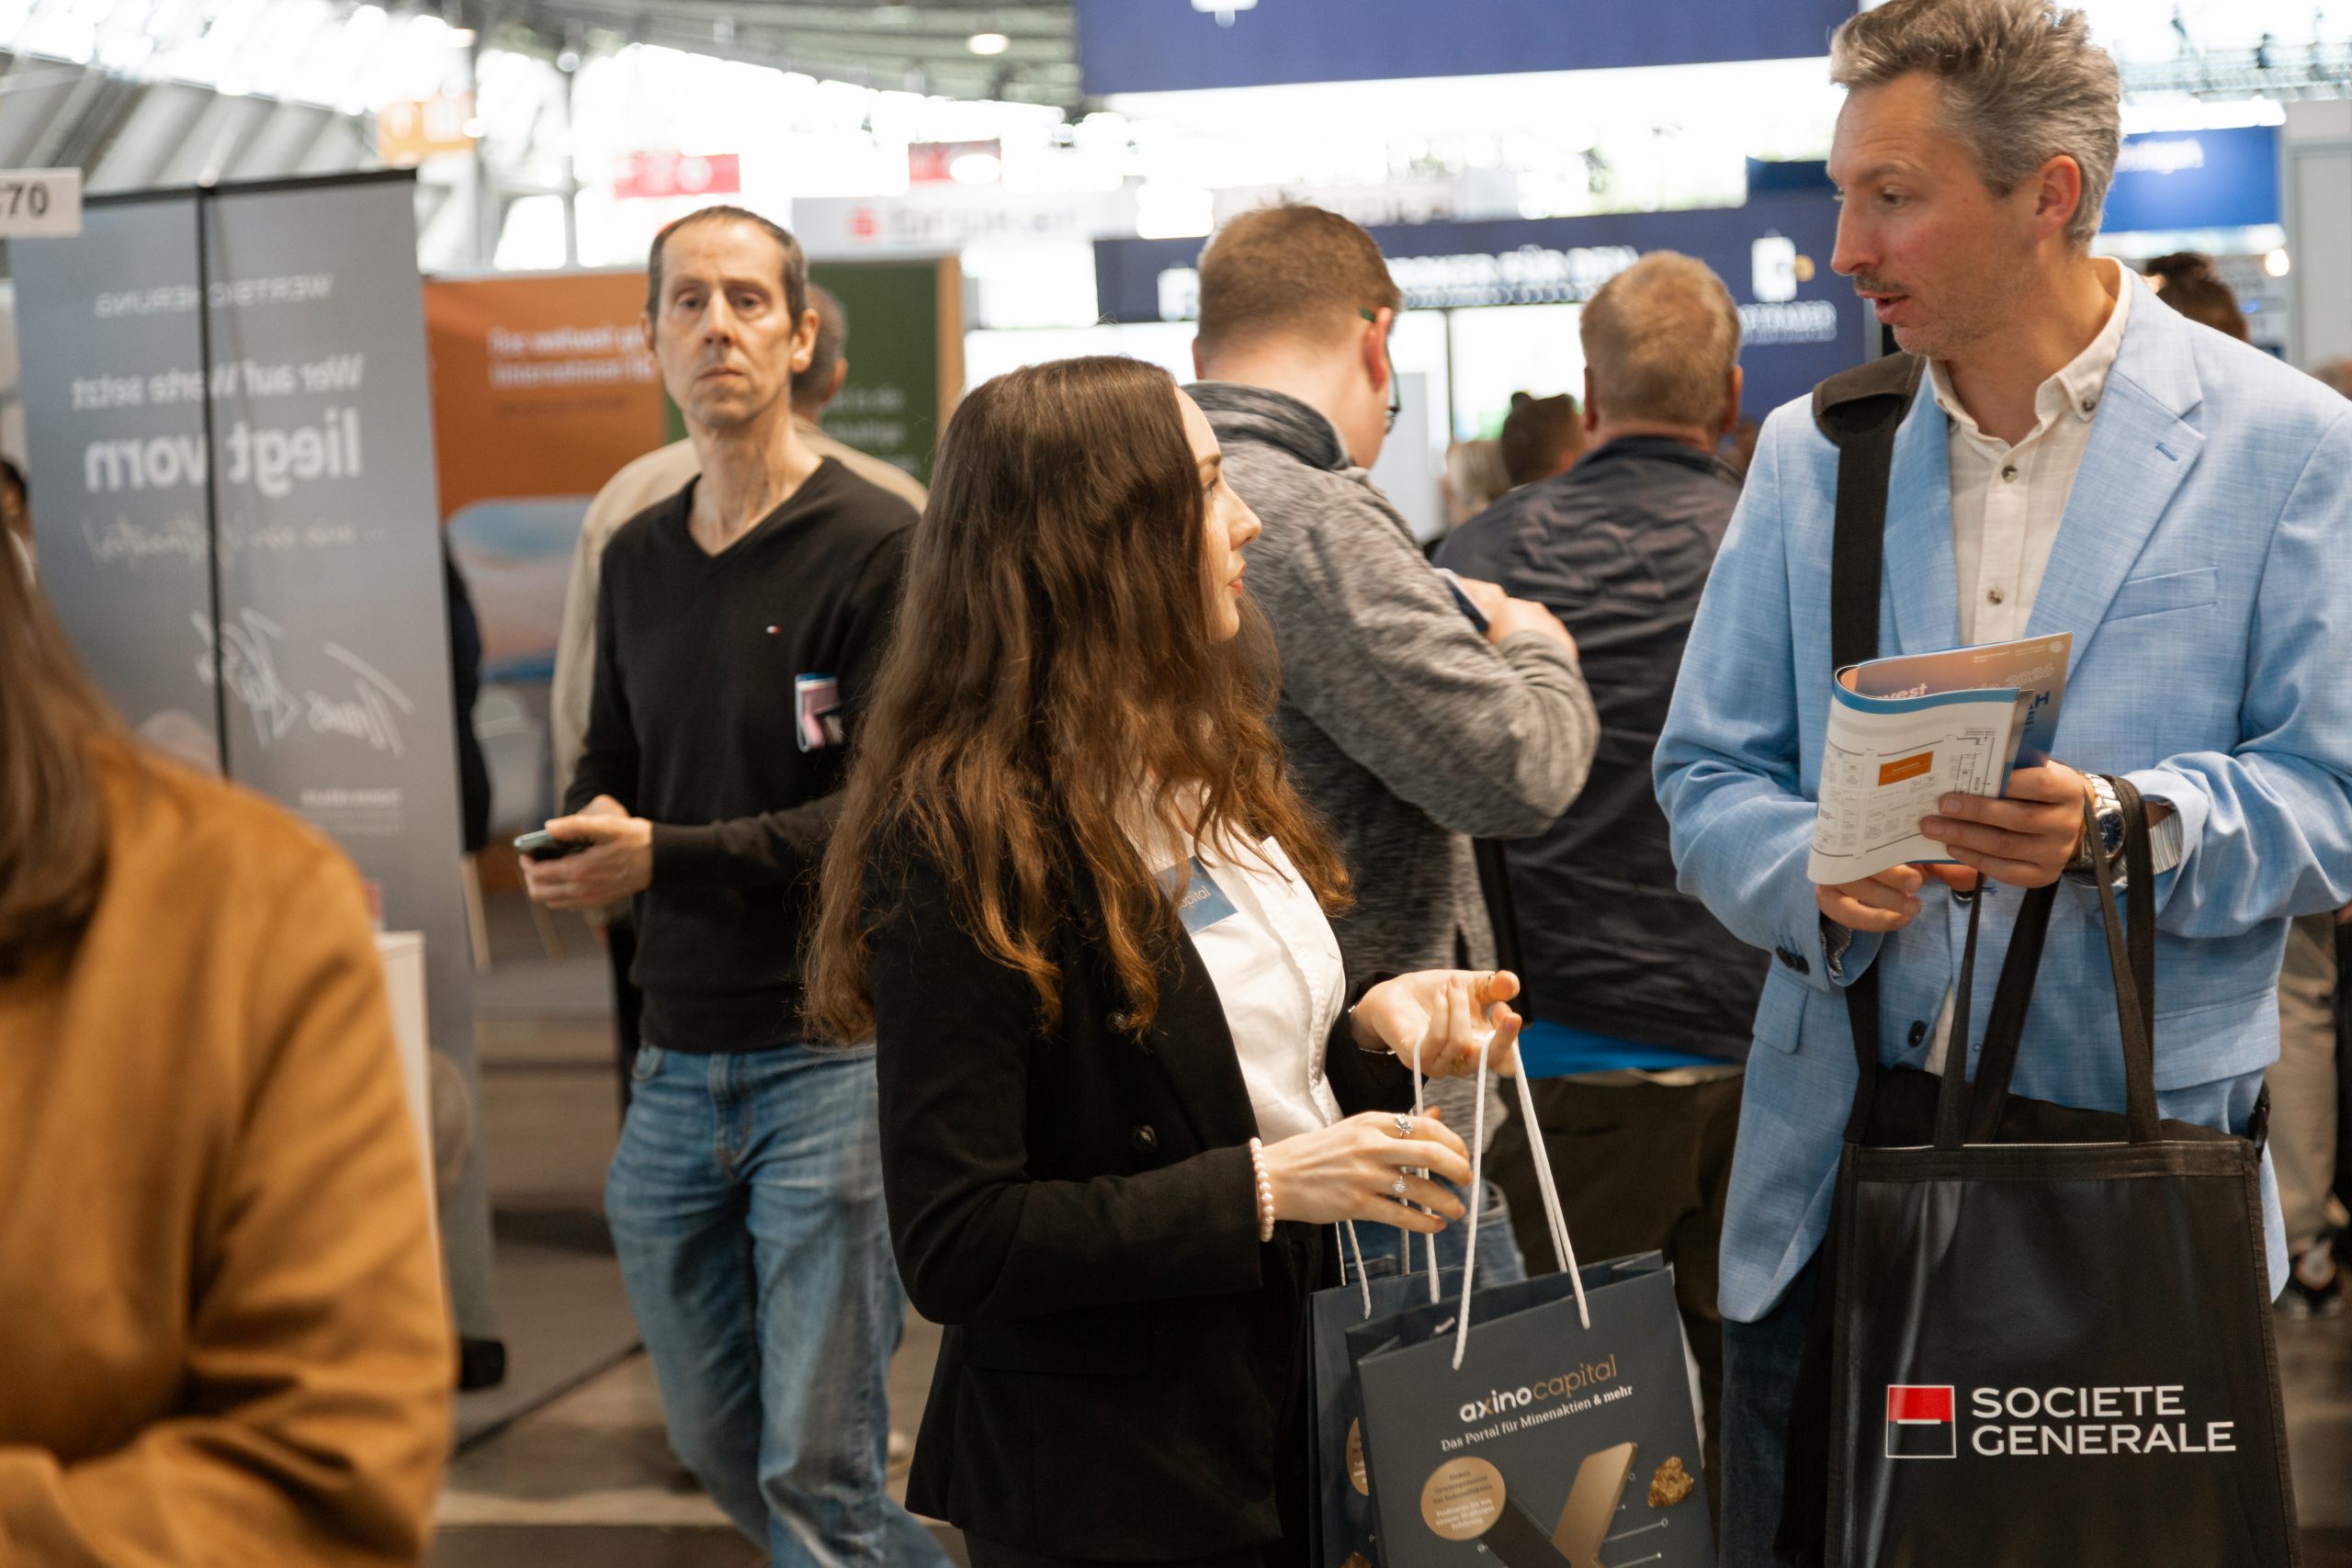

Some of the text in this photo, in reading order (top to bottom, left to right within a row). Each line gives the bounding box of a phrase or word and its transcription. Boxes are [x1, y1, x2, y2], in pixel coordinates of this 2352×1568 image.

[0, 181, 50, 220] 70
[1876, 682, 1928, 700] vest
[1459, 1353, 1618, 1423] axinocapital
[1972, 1384, 2186, 1418] SOCIETE
[1441, 1384, 1634, 1452] Das Portal für Minenaktien & mehr
[1972, 1421, 2236, 1456] GENERALE
